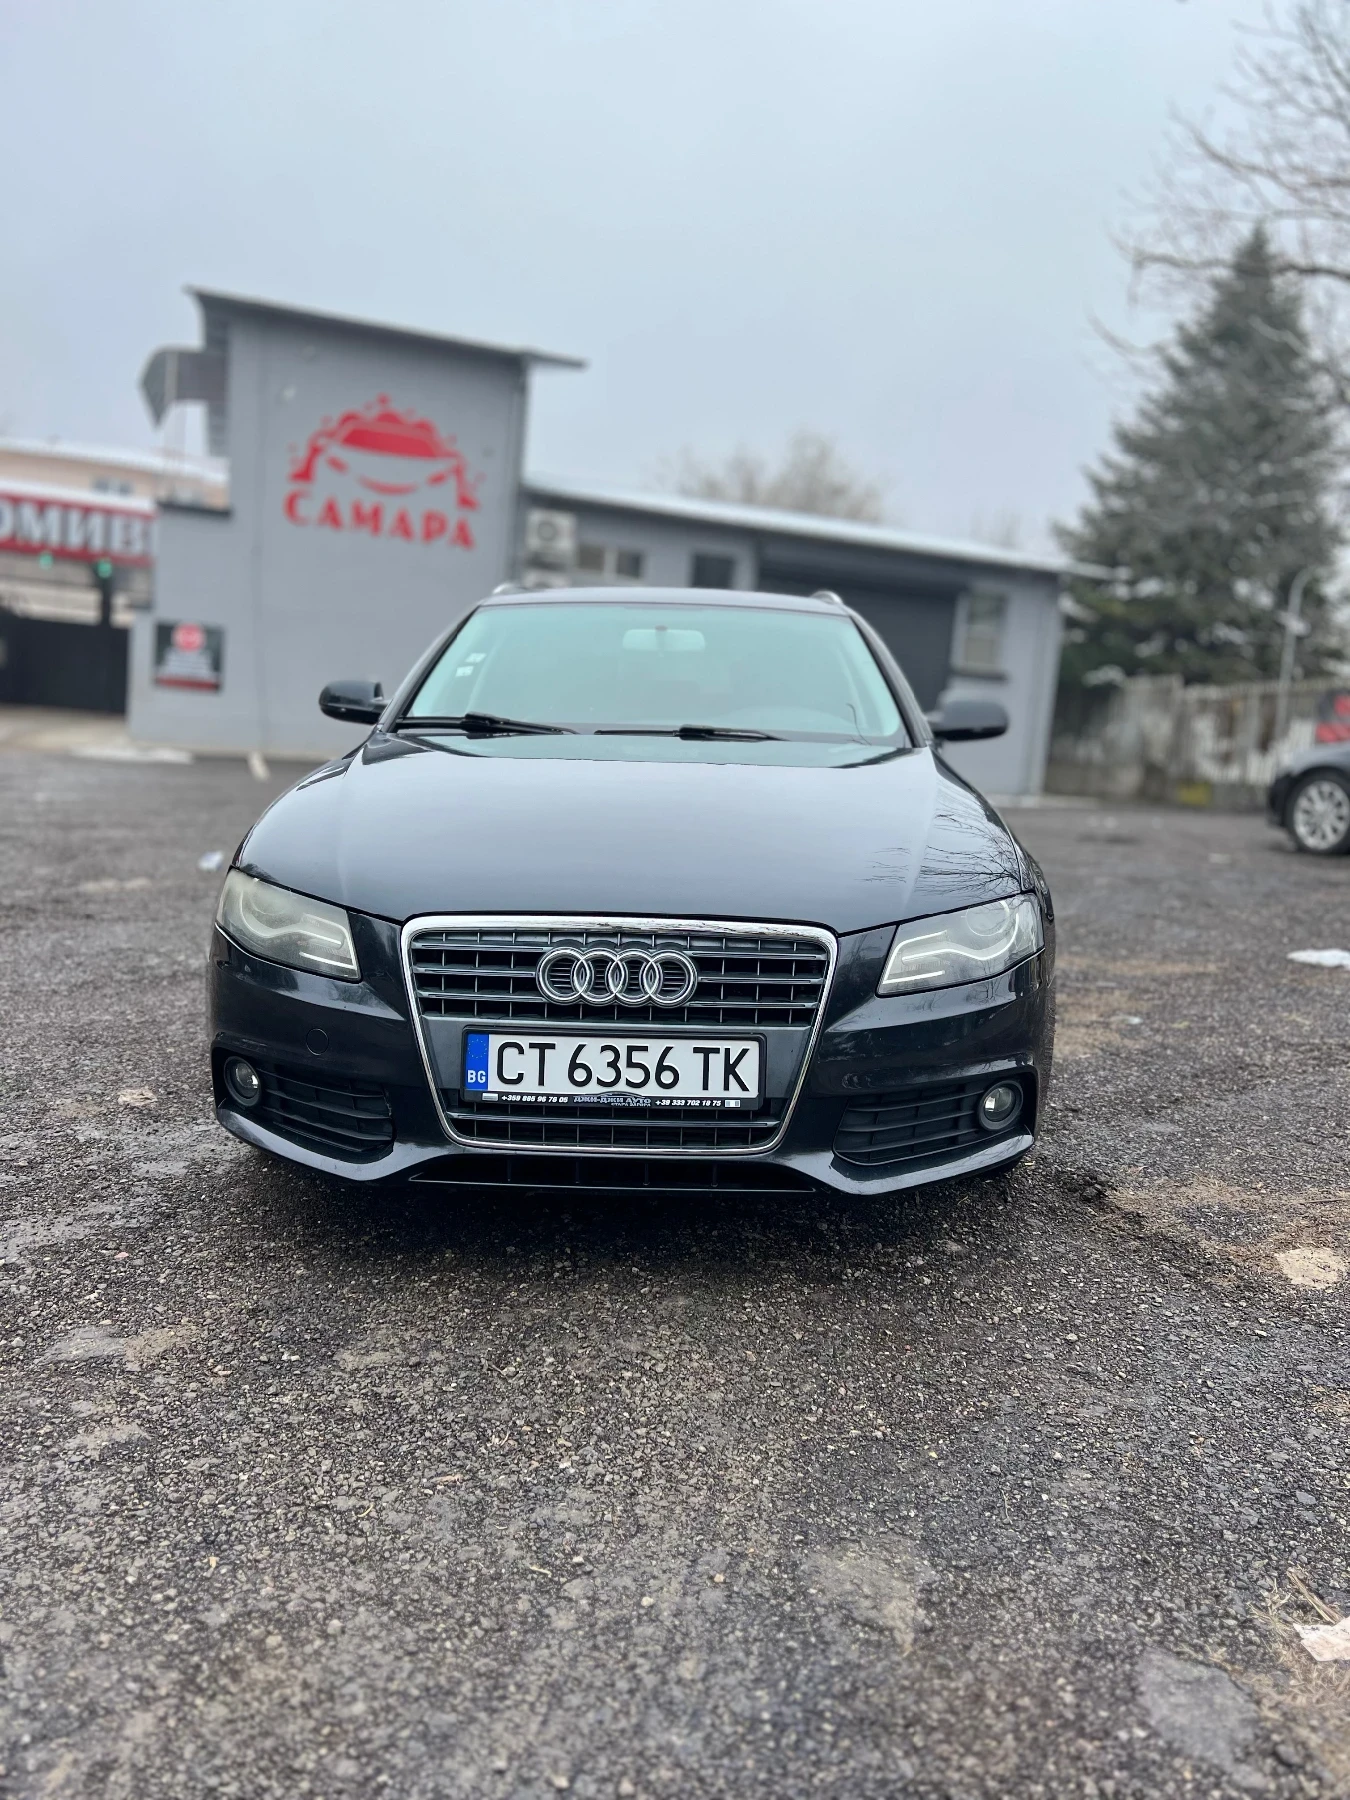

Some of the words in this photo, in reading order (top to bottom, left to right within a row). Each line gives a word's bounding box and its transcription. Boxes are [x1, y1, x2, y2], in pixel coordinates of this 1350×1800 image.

[283, 488, 477, 550] САМАРА
[496, 1040, 556, 1086] CT
[567, 1043, 680, 1089] 6356
[692, 1047, 750, 1092] TK
[467, 1070, 486, 1084] BG
[501, 1094, 521, 1102] +359
[686, 1099, 701, 1107] 702
